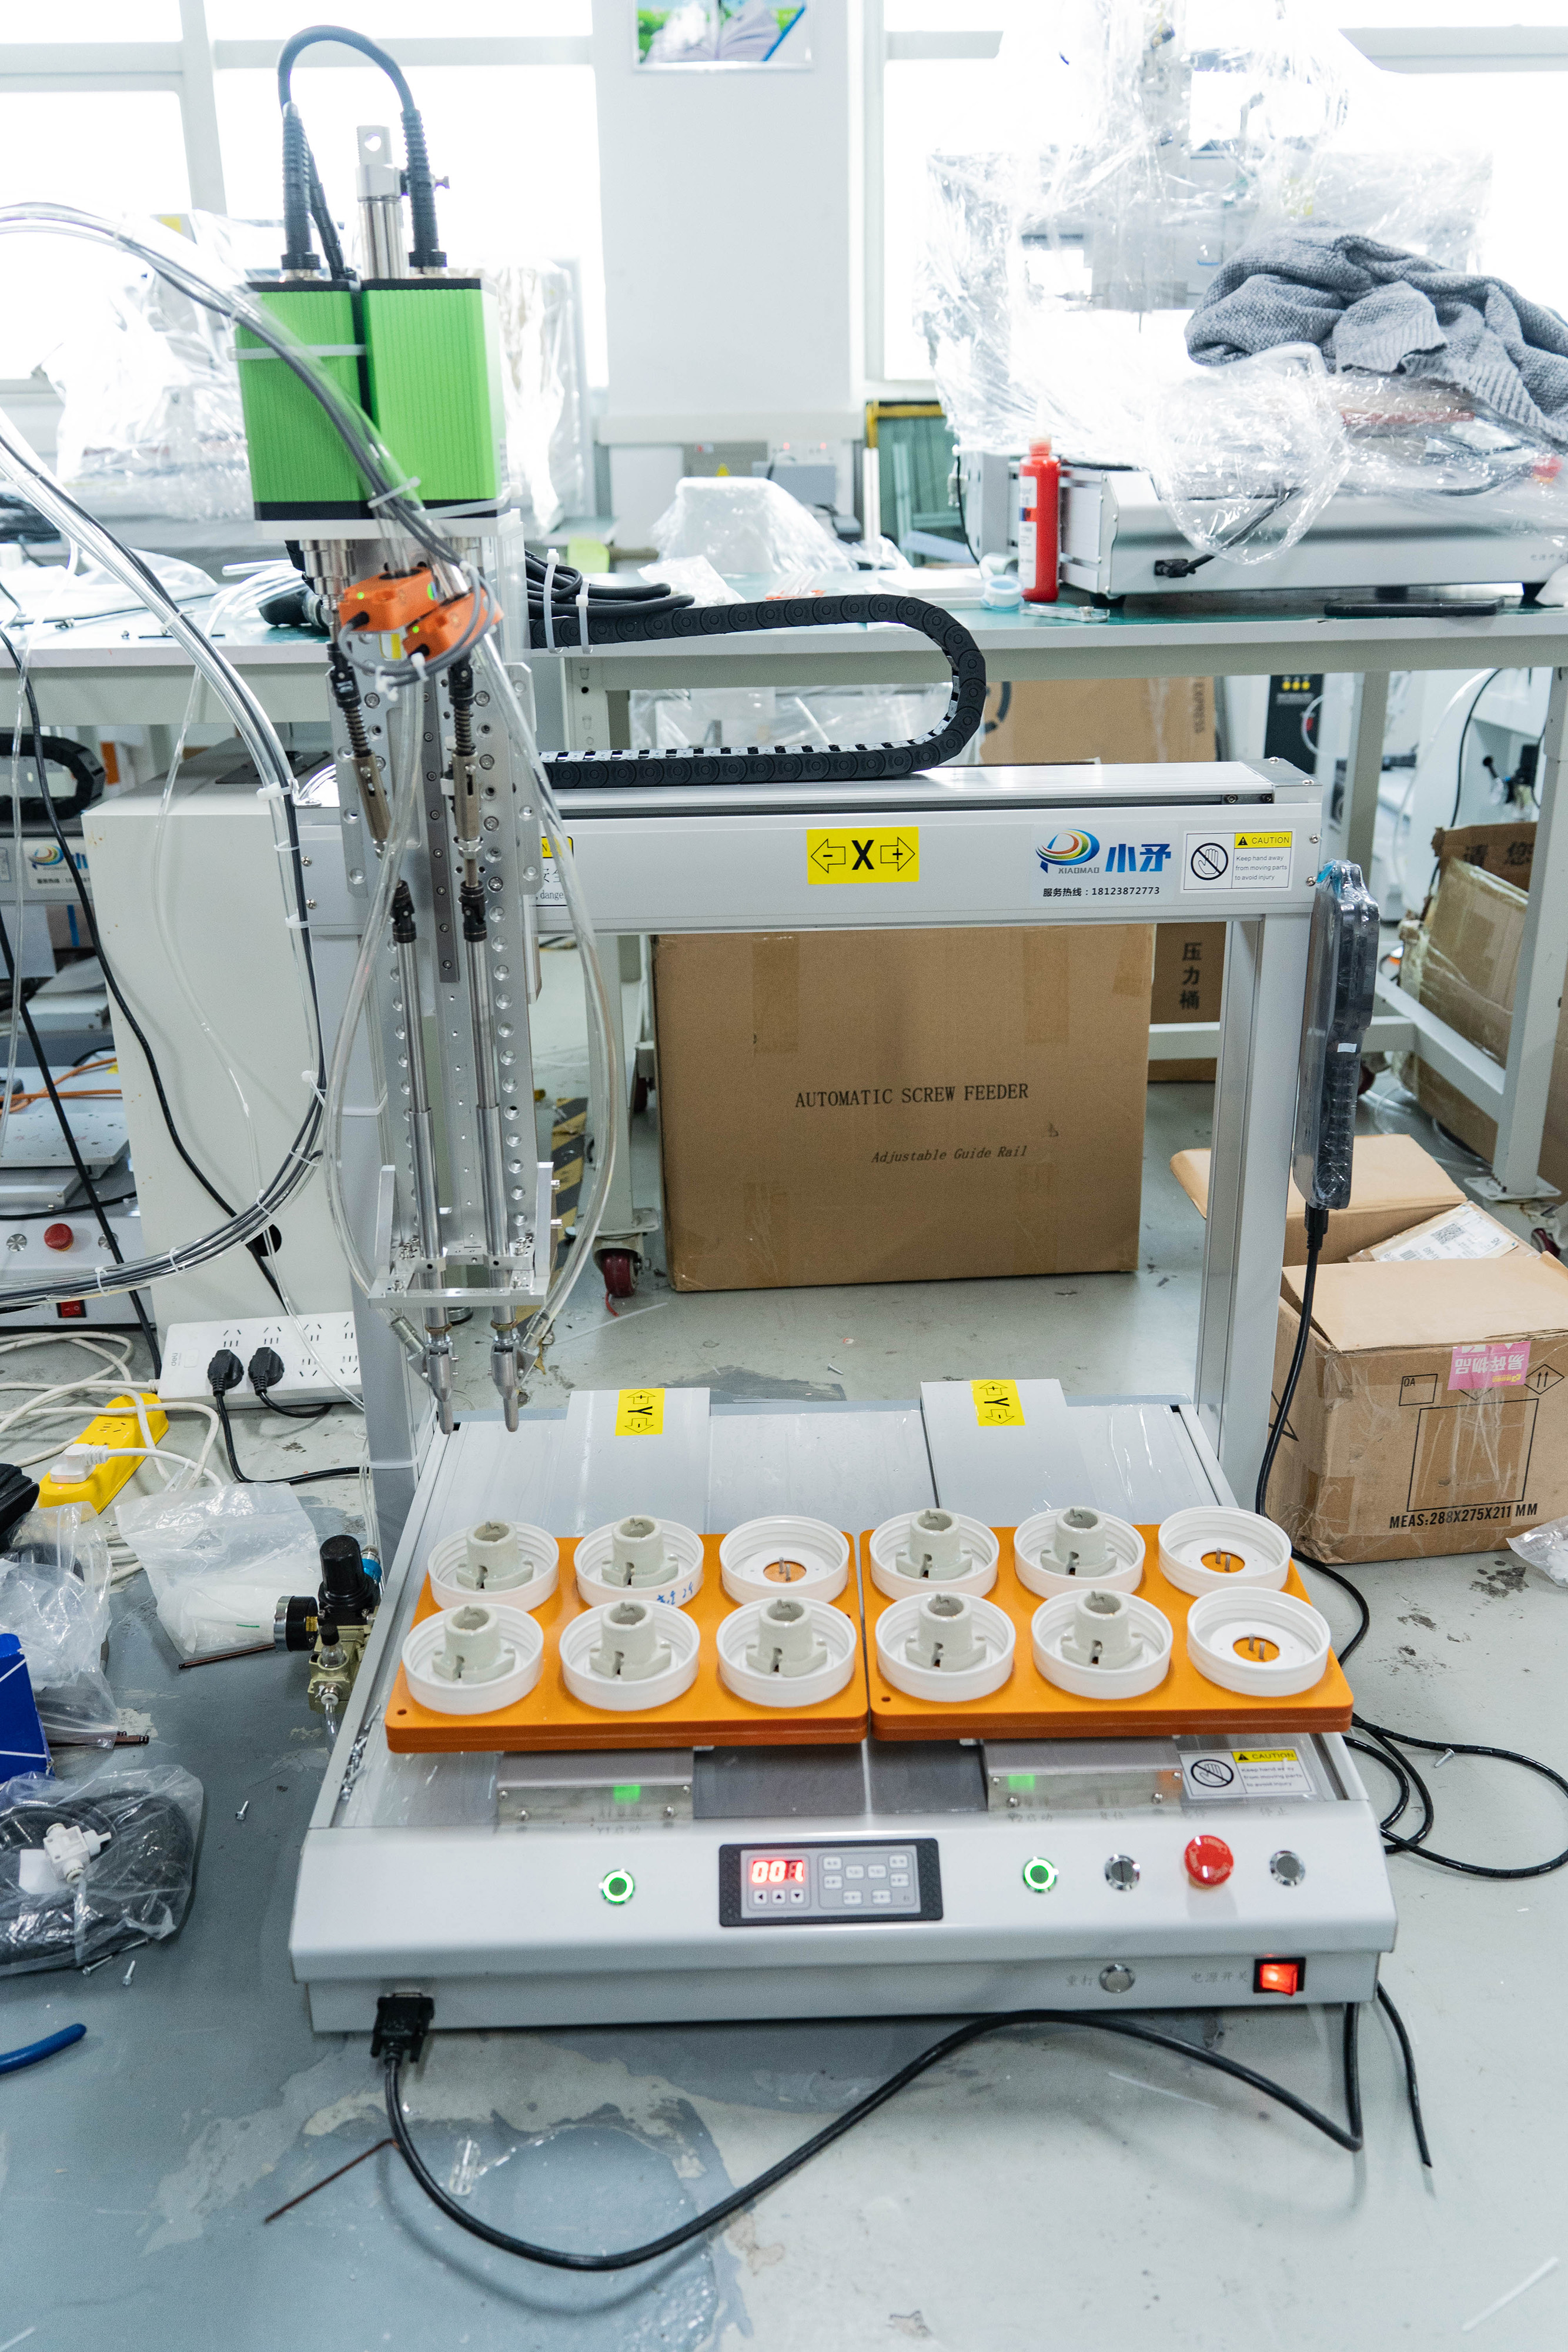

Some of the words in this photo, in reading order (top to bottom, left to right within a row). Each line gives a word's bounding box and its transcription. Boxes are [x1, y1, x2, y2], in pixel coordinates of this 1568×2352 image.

[851, 840, 875, 870] X
[1105, 843, 1171, 873] 小矛
[540, 890, 566, 901] dange
[1179, 942, 1202, 1010] 压力桶
[795, 1088, 892, 1108] AUTOMATIC
[901, 1086, 956, 1104] SCREW
[964, 1083, 1029, 1101] FEEDER
[871, 1149, 947, 1164] Adjustable
[954, 1147, 991, 1160] Guide
[998, 1145, 1028, 1158] Rail
[1455, 1354, 1524, 1375] 易碎物品
[1403, 1378, 1416, 1387] QA
[751, 1860, 804, 1884] 001
